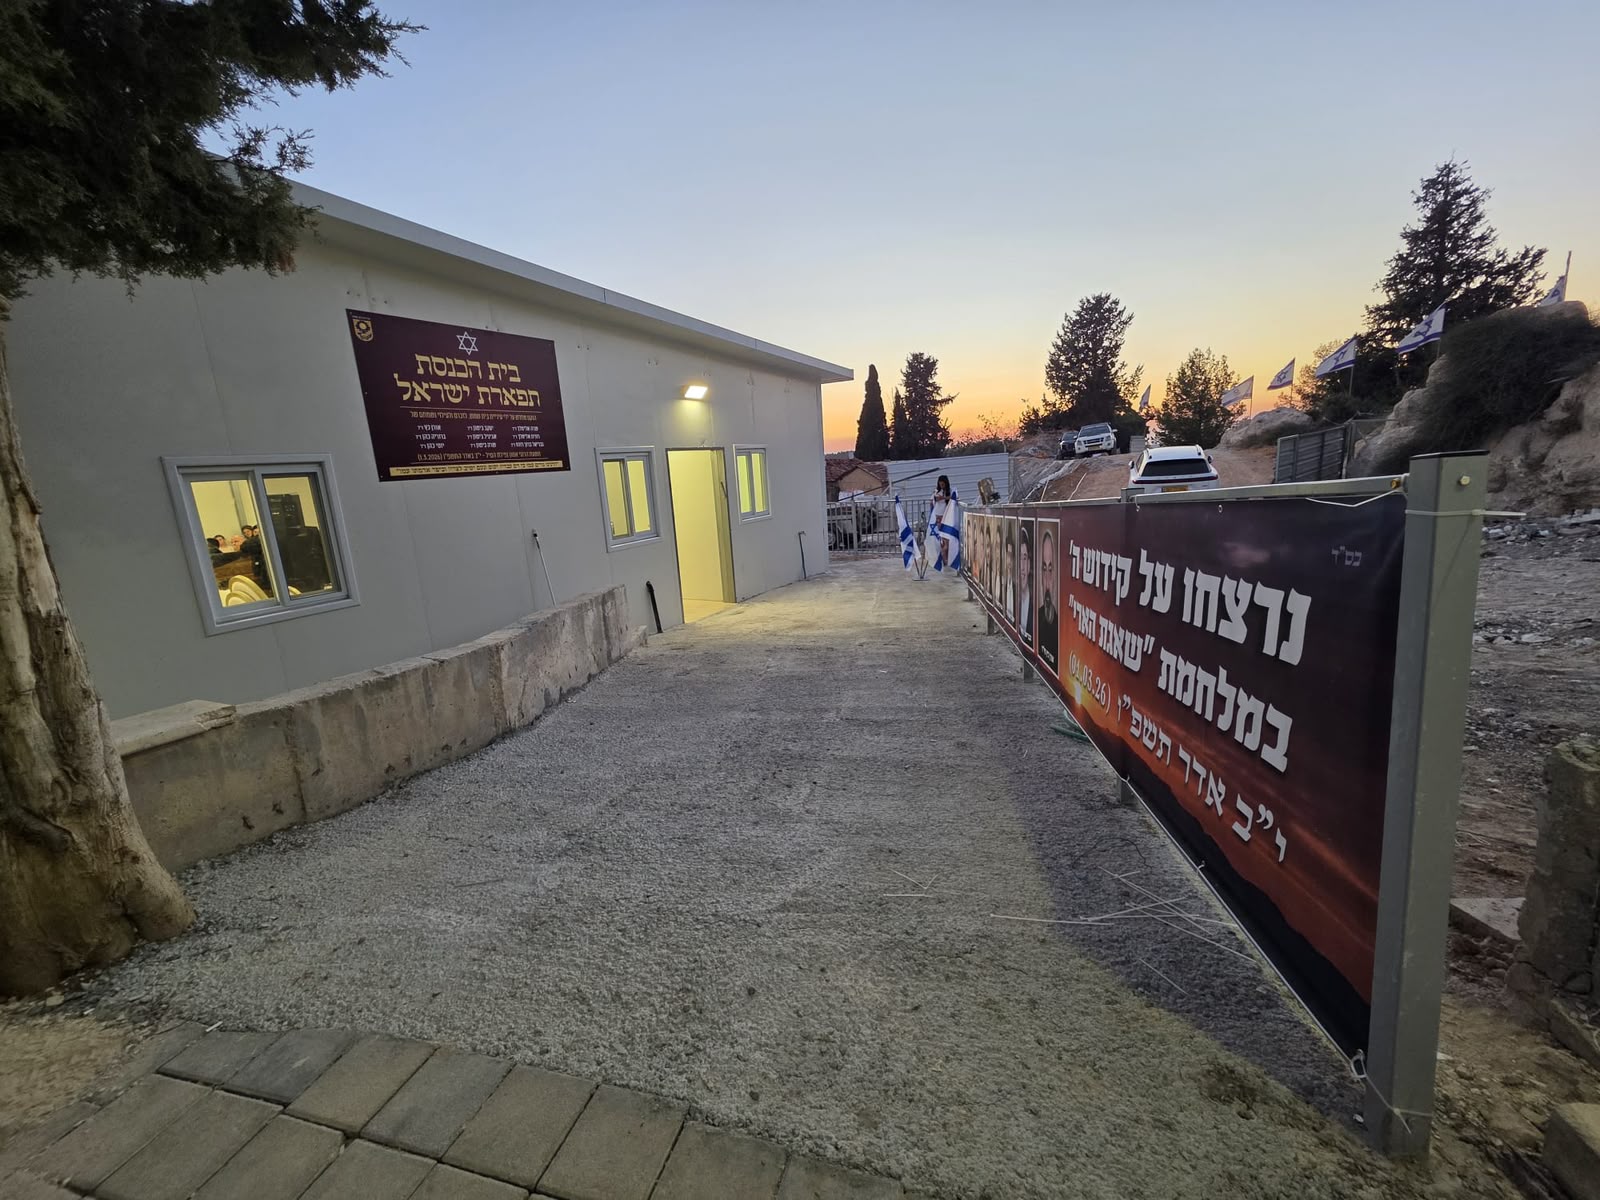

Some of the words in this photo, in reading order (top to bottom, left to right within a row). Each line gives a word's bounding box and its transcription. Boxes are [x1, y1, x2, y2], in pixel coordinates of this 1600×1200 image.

[393, 373, 470, 404] ישראל
[414, 353, 482, 380] הכנסת
[476, 385, 541, 407] תפארת
[487, 360, 521, 383] בית
[1082, 547, 1133, 607] קידוש
[1138, 548, 1175, 614] על
[1331, 545, 1363, 567] בס"ד
[1068, 593, 1097, 643] הארי"
[1098, 613, 1156, 673] "שאגת
[1181, 566, 1312, 667] נרצחו
[1068, 650, 1112, 715] (01.03.26)
[1157, 645, 1293, 774] במלחמת
[1116, 693, 1172, 767] תשפ"ו
[1178, 743, 1226, 817] אדר
[1231, 792, 1287, 864] י"ב
